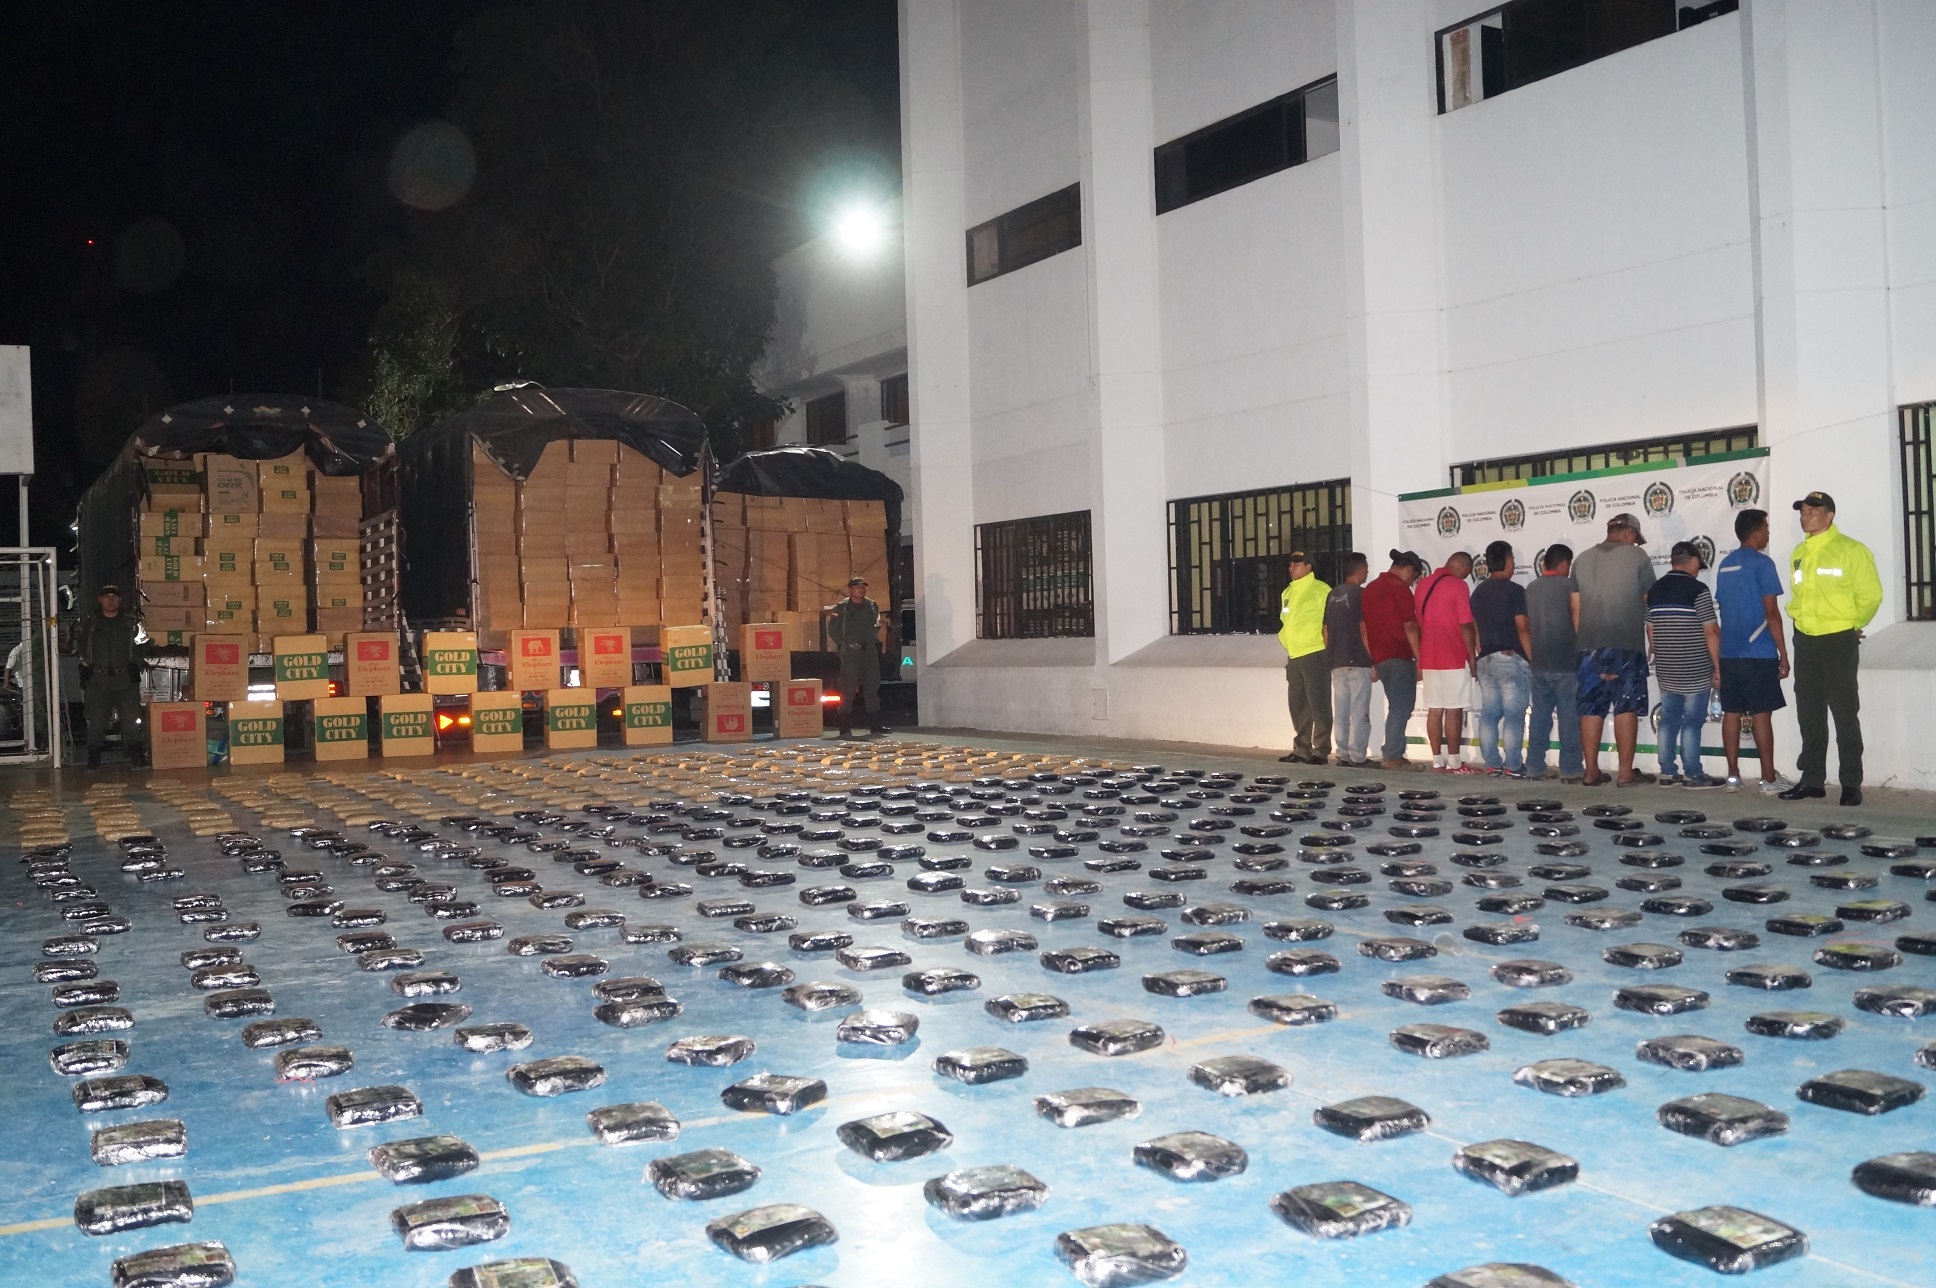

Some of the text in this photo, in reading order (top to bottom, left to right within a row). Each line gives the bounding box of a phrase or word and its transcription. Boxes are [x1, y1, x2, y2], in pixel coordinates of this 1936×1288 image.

[434, 651, 470, 662] GOLD
[675, 646, 707, 659] GOLD
[283, 655, 322, 668] GOLD
[677, 657, 705, 669] CITY
[205, 669, 239, 677] Elephant
[285, 667, 319, 679] CITY
[357, 665, 391, 673] Elephant
[436, 663, 468, 673] CITY
[555, 707, 590, 718] GOLD
[632, 704, 665, 715] GOLD
[390, 713, 427, 725] GOLD
[480, 710, 516, 722] GOLD
[634, 715, 663, 726] CITY
[237, 720, 277, 733] GOLD
[322, 716, 361, 729] GOLD
[482, 721, 513, 733] CITY
[557, 718, 588, 729] CITY
[325, 728, 358, 740] CITY
[392, 725, 425, 736] CITY
[240, 732, 273, 744] CITY
